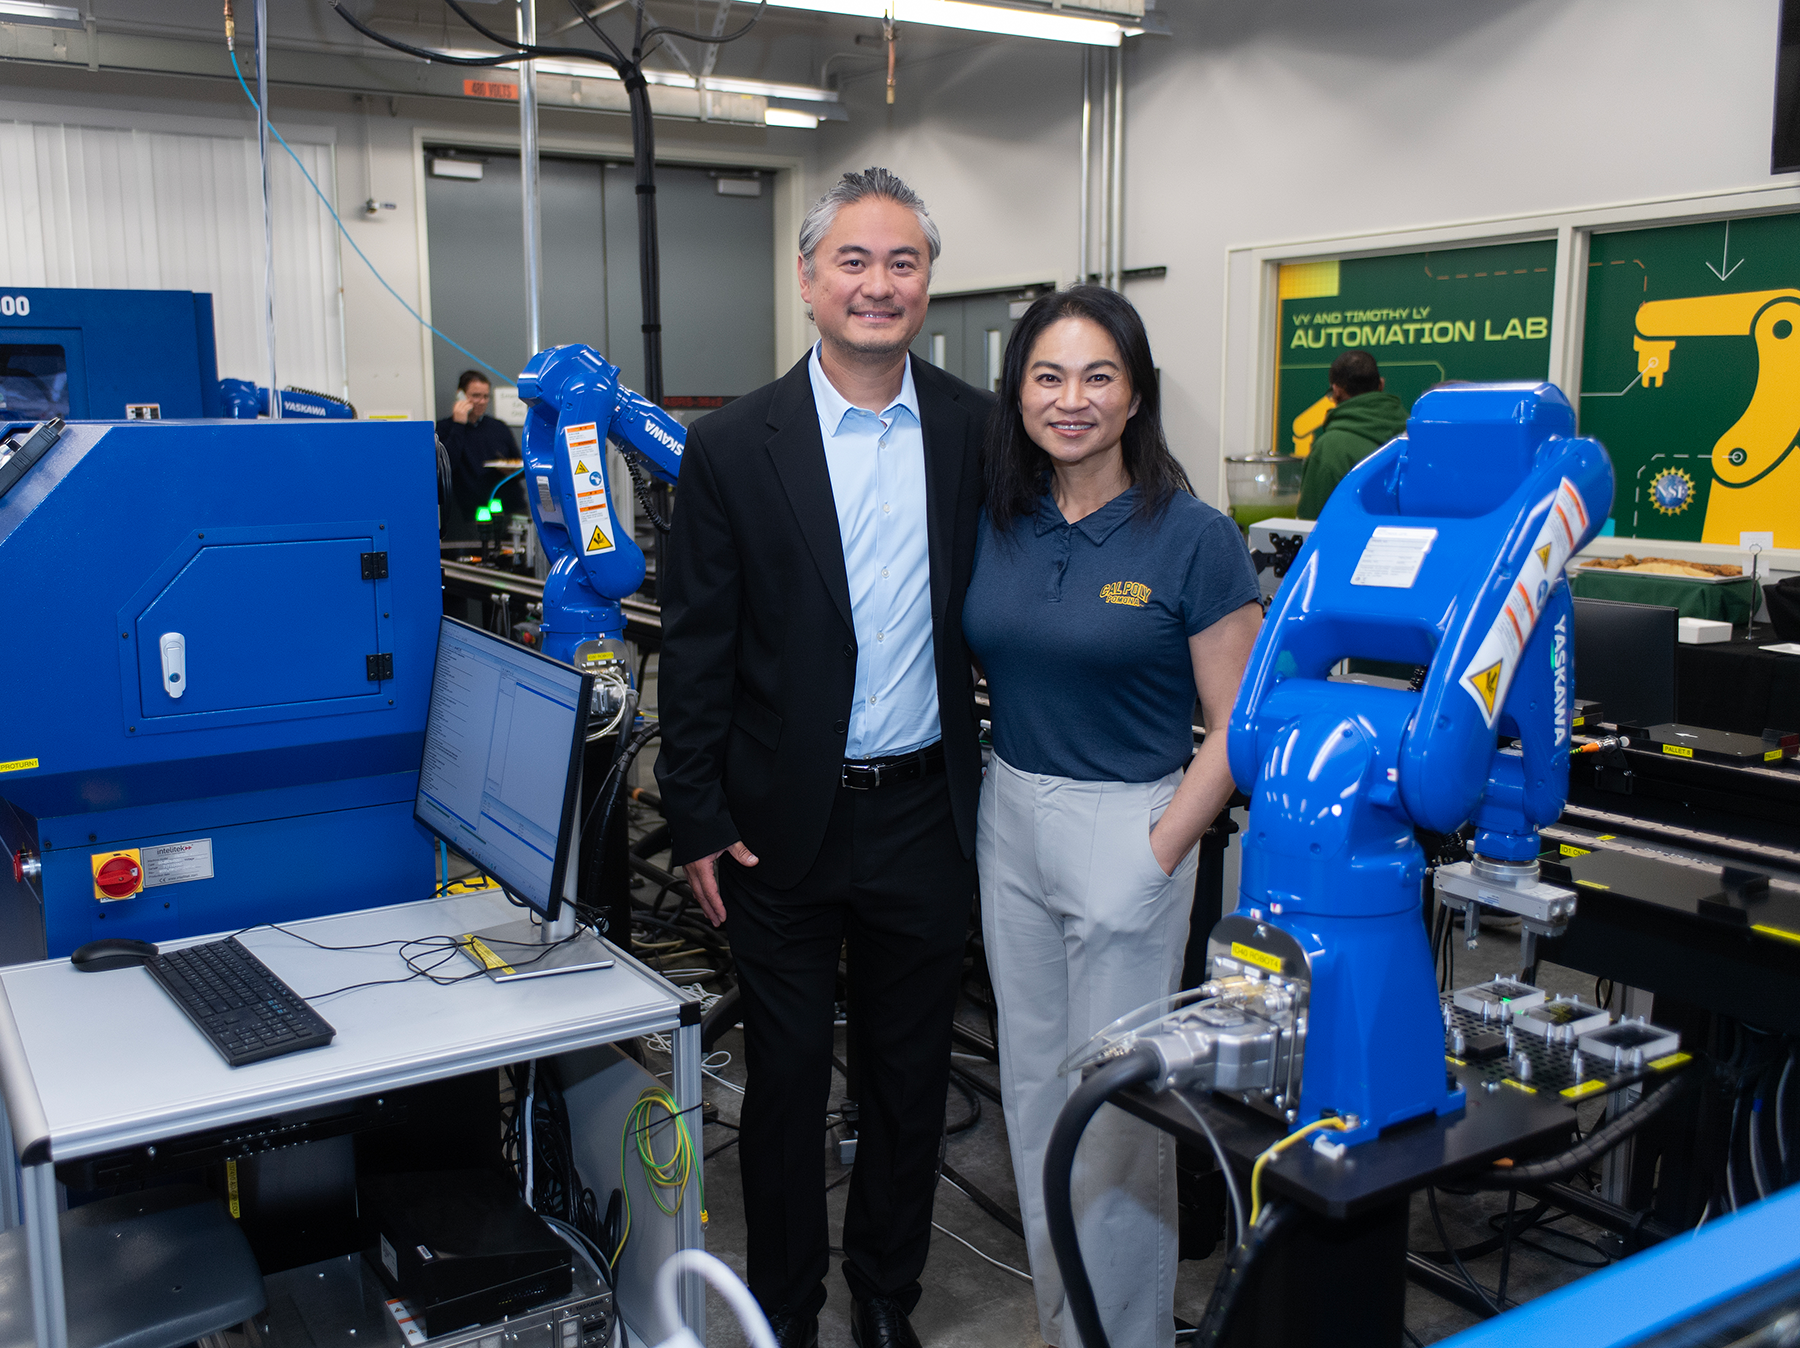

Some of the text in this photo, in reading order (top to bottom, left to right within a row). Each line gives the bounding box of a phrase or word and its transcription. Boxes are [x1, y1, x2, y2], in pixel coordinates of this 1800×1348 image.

[488, 83, 512, 99] VOLTS
[0, 295, 30, 317] 00
[1292, 306, 1431, 326] VY AND TIMOTHY LY
[1290, 316, 1548, 350] AUTOMATION LAB
[284, 400, 327, 417] YASKAWA
[1099, 581, 1152, 603] CAL POLY
[1105, 595, 1141, 607] POMONA
[1554, 614, 1566, 747] YASKAWA
[1664, 745, 1686, 755] PALLET
[157, 845, 185, 855] intelitek
[1232, 944, 1248, 957] ID40
[1249, 951, 1279, 967] ROBOT4
[576, 1299, 604, 1310] YASKAWA
